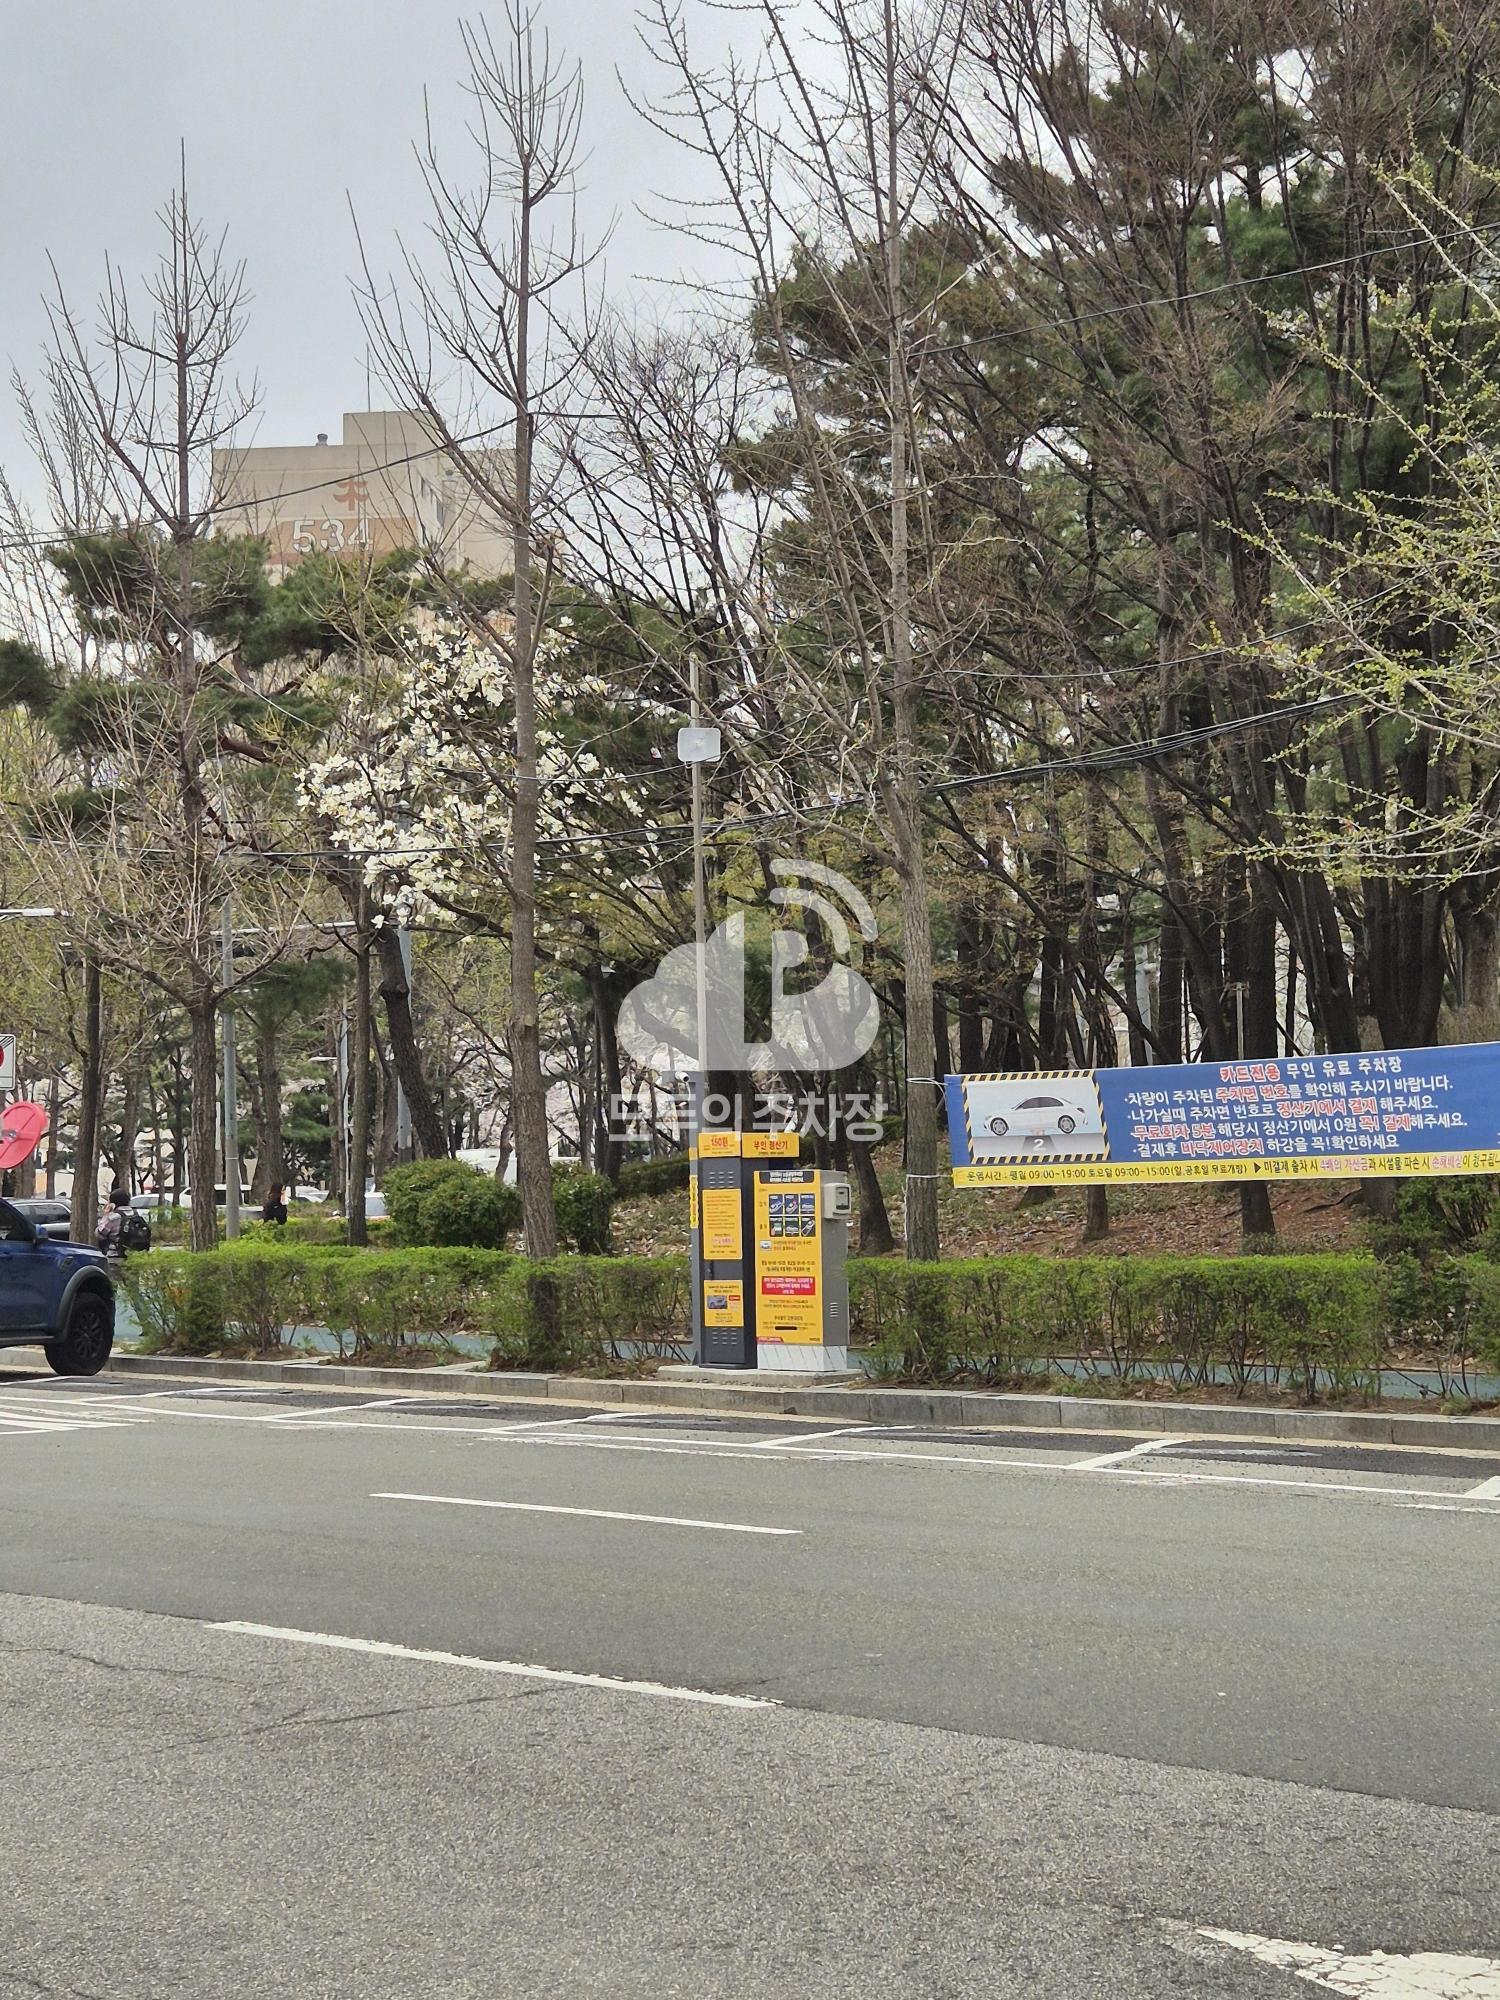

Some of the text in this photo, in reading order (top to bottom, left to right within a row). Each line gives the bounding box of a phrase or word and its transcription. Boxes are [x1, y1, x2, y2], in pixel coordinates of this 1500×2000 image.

[293, 519, 374, 553] 534
[1219, 1056, 1402, 1084] 카드전용 무인 유료 주차장
[1128, 1075, 1453, 1107] 차량이 주차된 주차면 번호를 확인해 주시기 바랍니다.
[1131, 1095, 1438, 1123] 나가실때 주차면 번호로 정산기에서 결제 해주세요.
[1134, 1124, 1190, 1141] 무료회차
[1191, 1122, 1216, 1139] 5분
[1217, 1121, 1259, 1137] 해당시
[1262, 1118, 1331, 1136] 정산기에서
[1333, 1117, 1357, 1133] 0원
[1359, 1115, 1380, 1133] 꼭!
[1033, 1138, 1046, 1152] 2
[1137, 1142, 1178, 1157] 결제후
[1180, 1138, 1264, 1157] 바닥제어장치
[1266, 1136, 1308, 1153] 하강을
[1009, 1170, 1026, 1181] 평일
[1028, 1168, 1086, 1179] 09:00~19:00
[1088, 1167, 1113, 1178] 토요일
[1291, 1159, 1308, 1174] 출차
[1310, 1159, 1319, 1172] 시
[1404, 1155, 1421, 1170] 파손
[1421, 1155, 1431, 1170] 시
